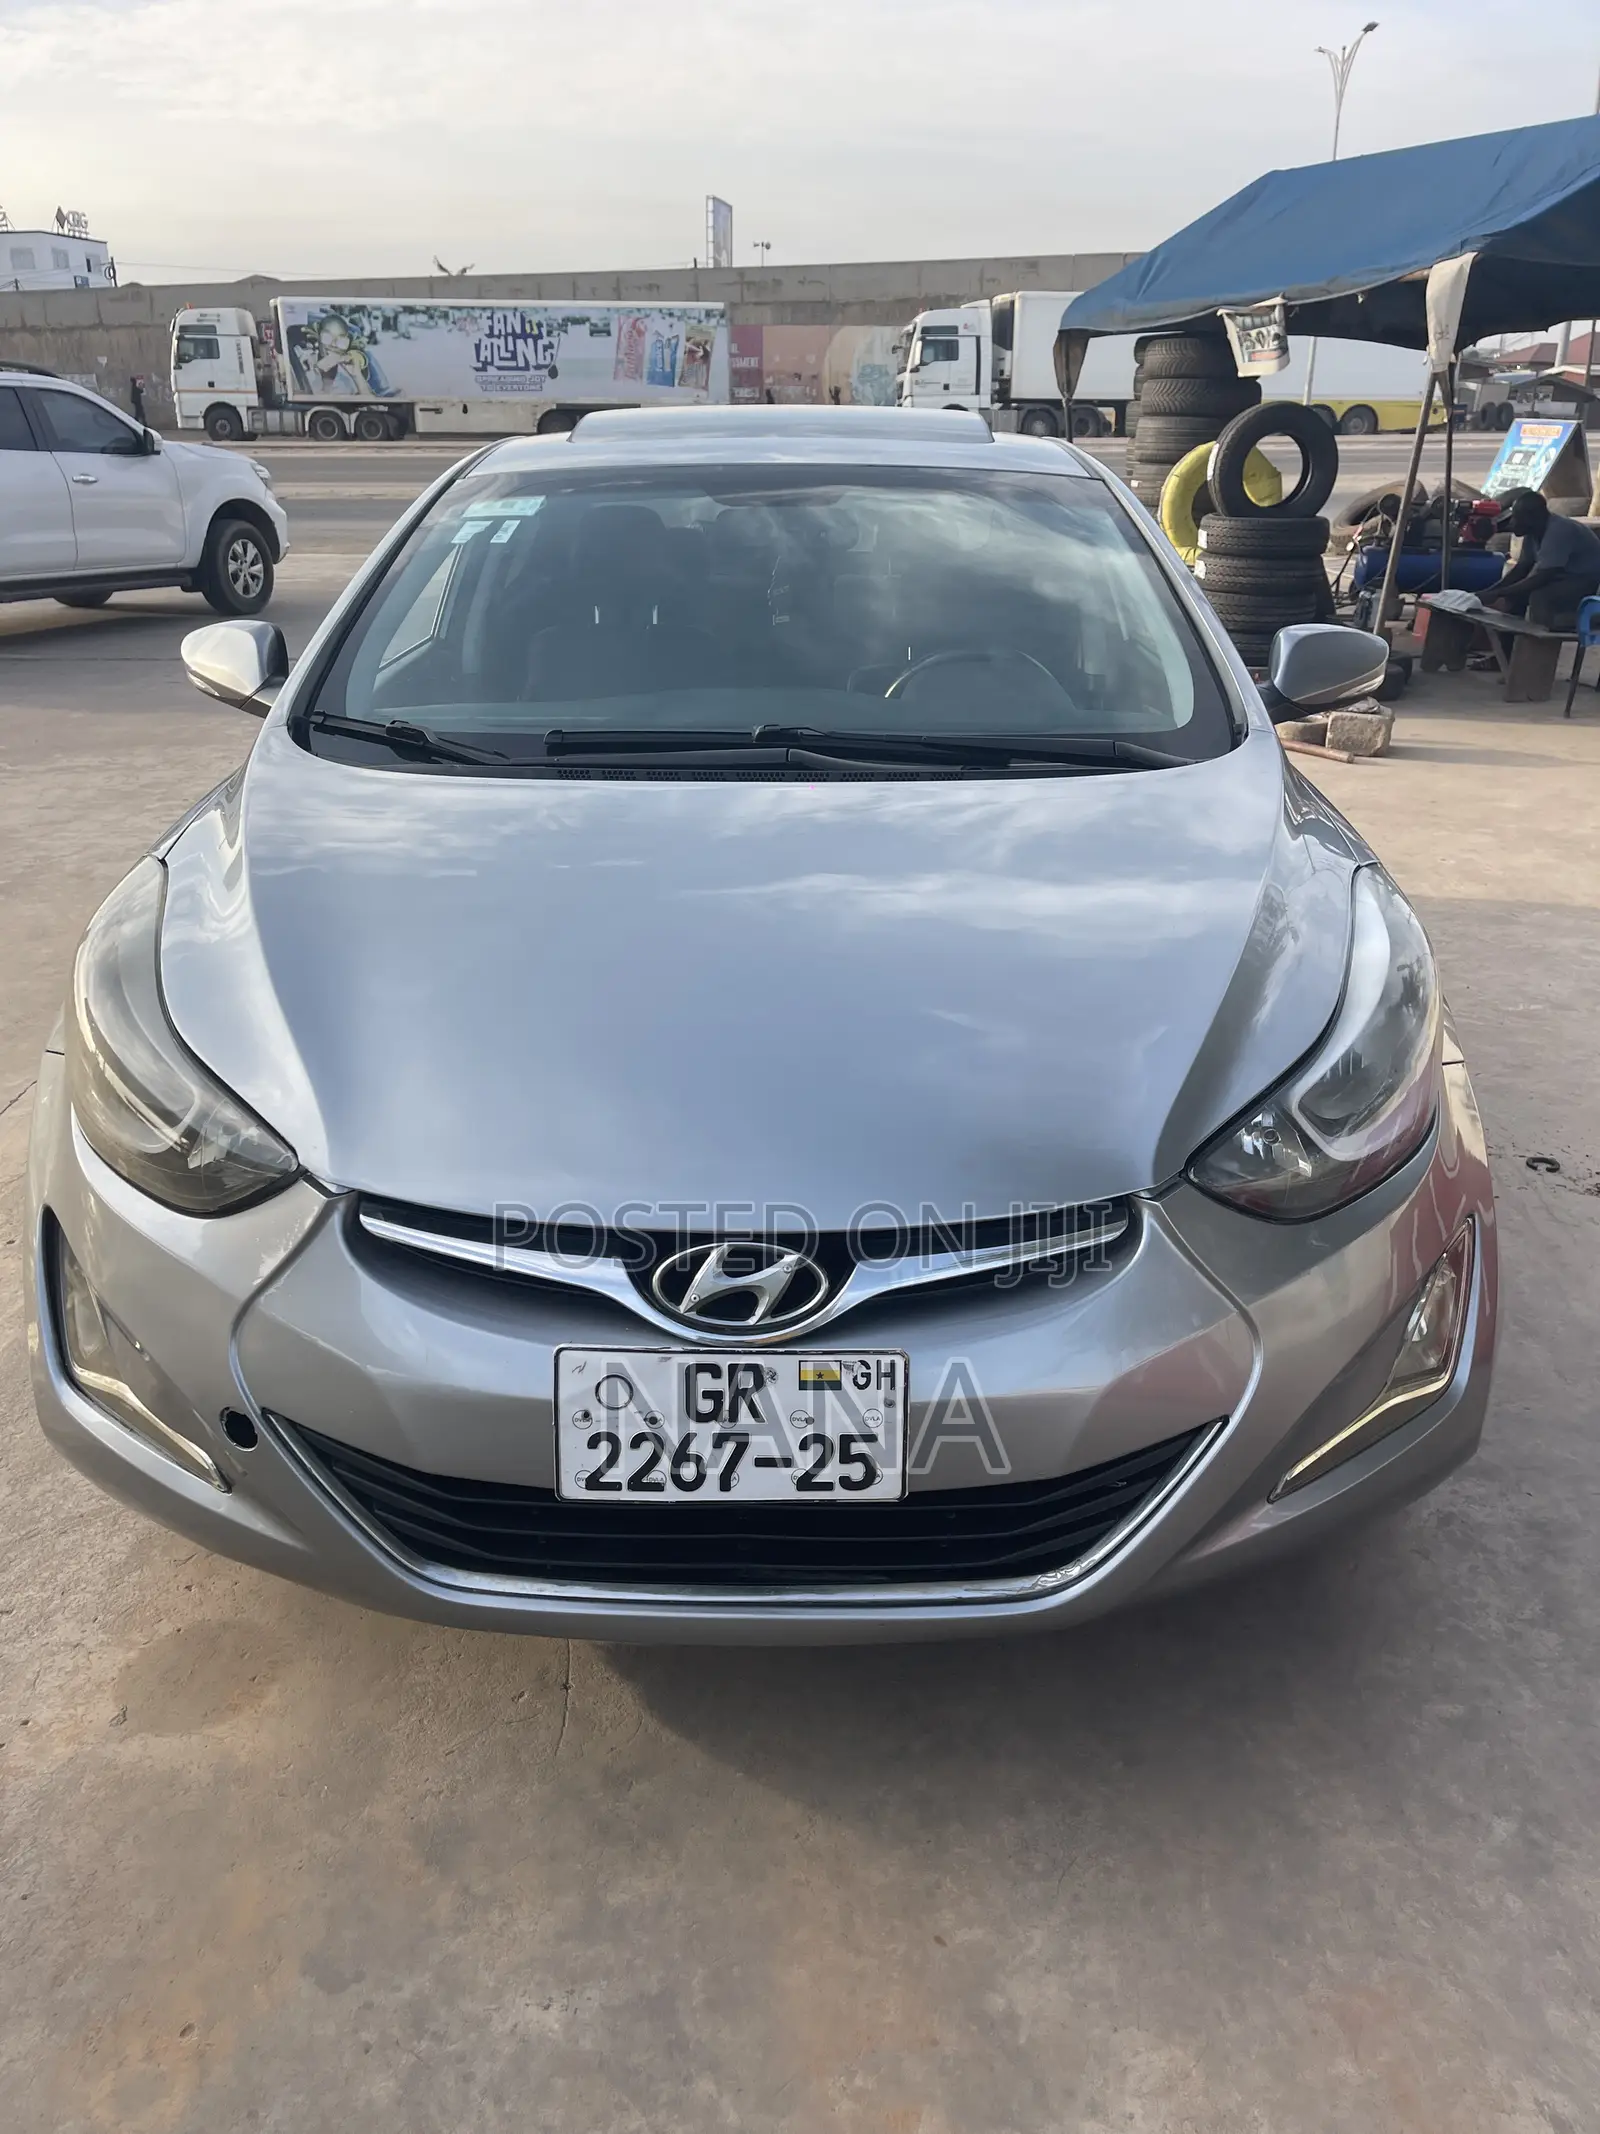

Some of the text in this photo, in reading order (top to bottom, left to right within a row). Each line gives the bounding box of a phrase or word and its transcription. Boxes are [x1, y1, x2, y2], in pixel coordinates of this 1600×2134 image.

[481, 311, 522, 335] FAN
[852, 1359, 896, 1391] GH
[685, 1362, 766, 1423] GR
[865, 1414, 881, 1422] DVLA
[585, 1431, 878, 1492] 2267-25
